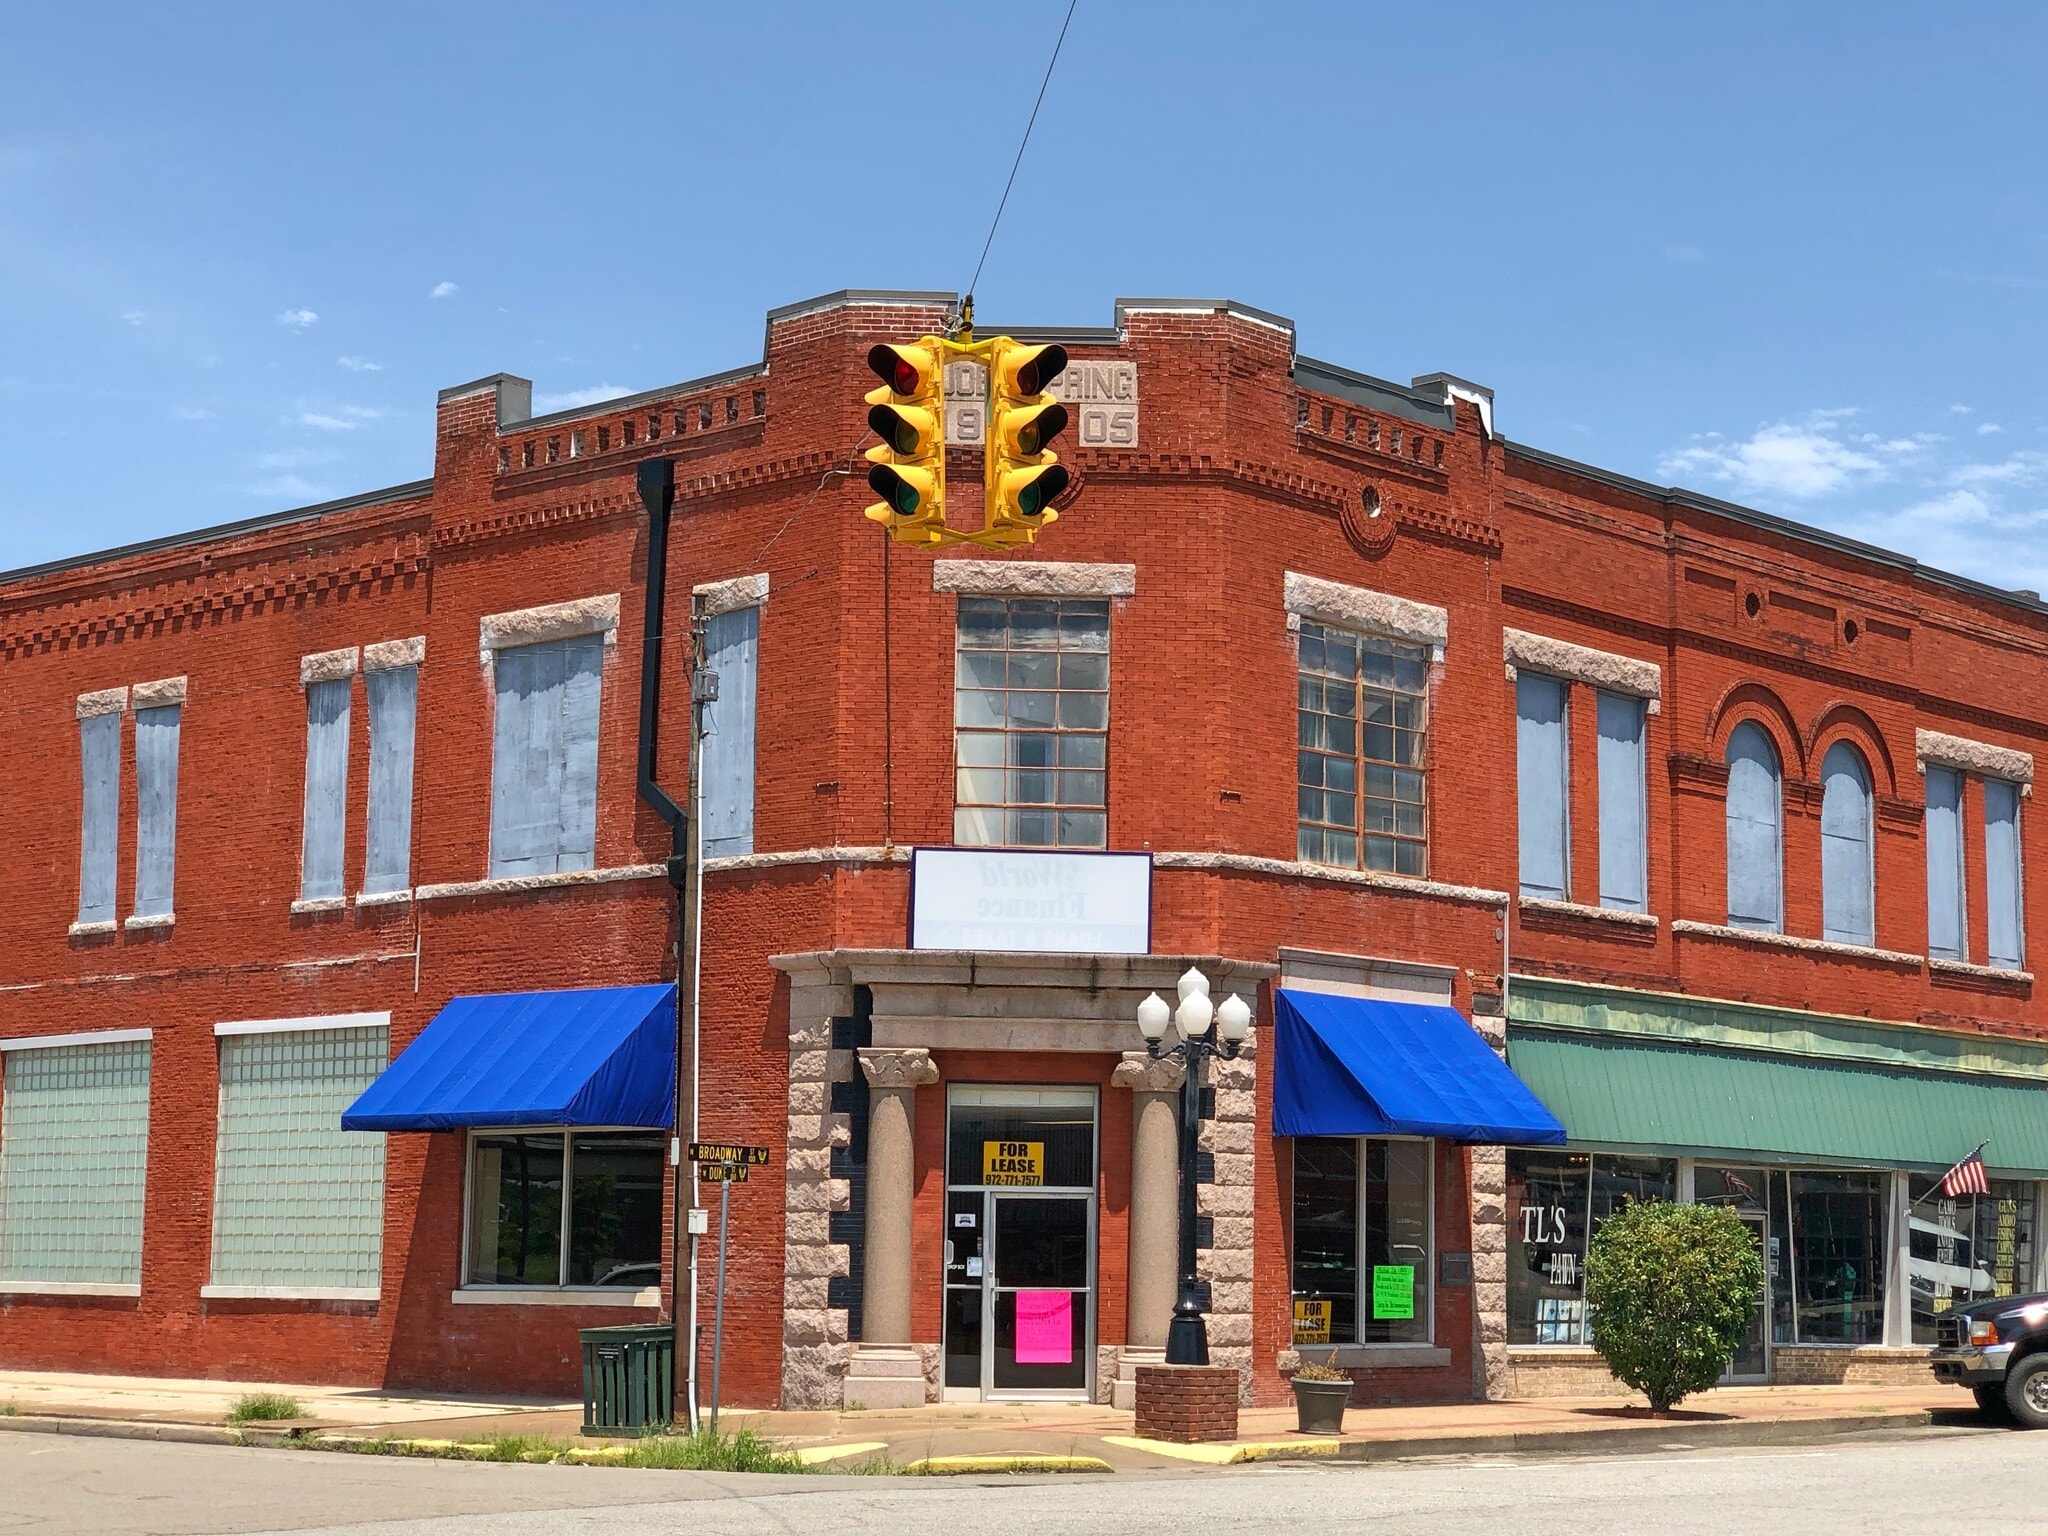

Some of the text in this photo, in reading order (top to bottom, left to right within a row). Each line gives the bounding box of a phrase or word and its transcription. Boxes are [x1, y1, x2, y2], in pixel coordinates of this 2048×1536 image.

[1084, 411, 1136, 444] 05
[699, 1146, 743, 1161] BROADWAY
[999, 1143, 1028, 1157] FOR
[991, 1159, 1035, 1173] LEASE
[985, 1174, 1040, 1186] 972-771-7577
[1938, 1199, 1956, 1215] CAMO
[1520, 1205, 1566, 1244] TL'S
[1550, 1253, 1577, 1285] PAWN
[1304, 1303, 1322, 1316] FOR
